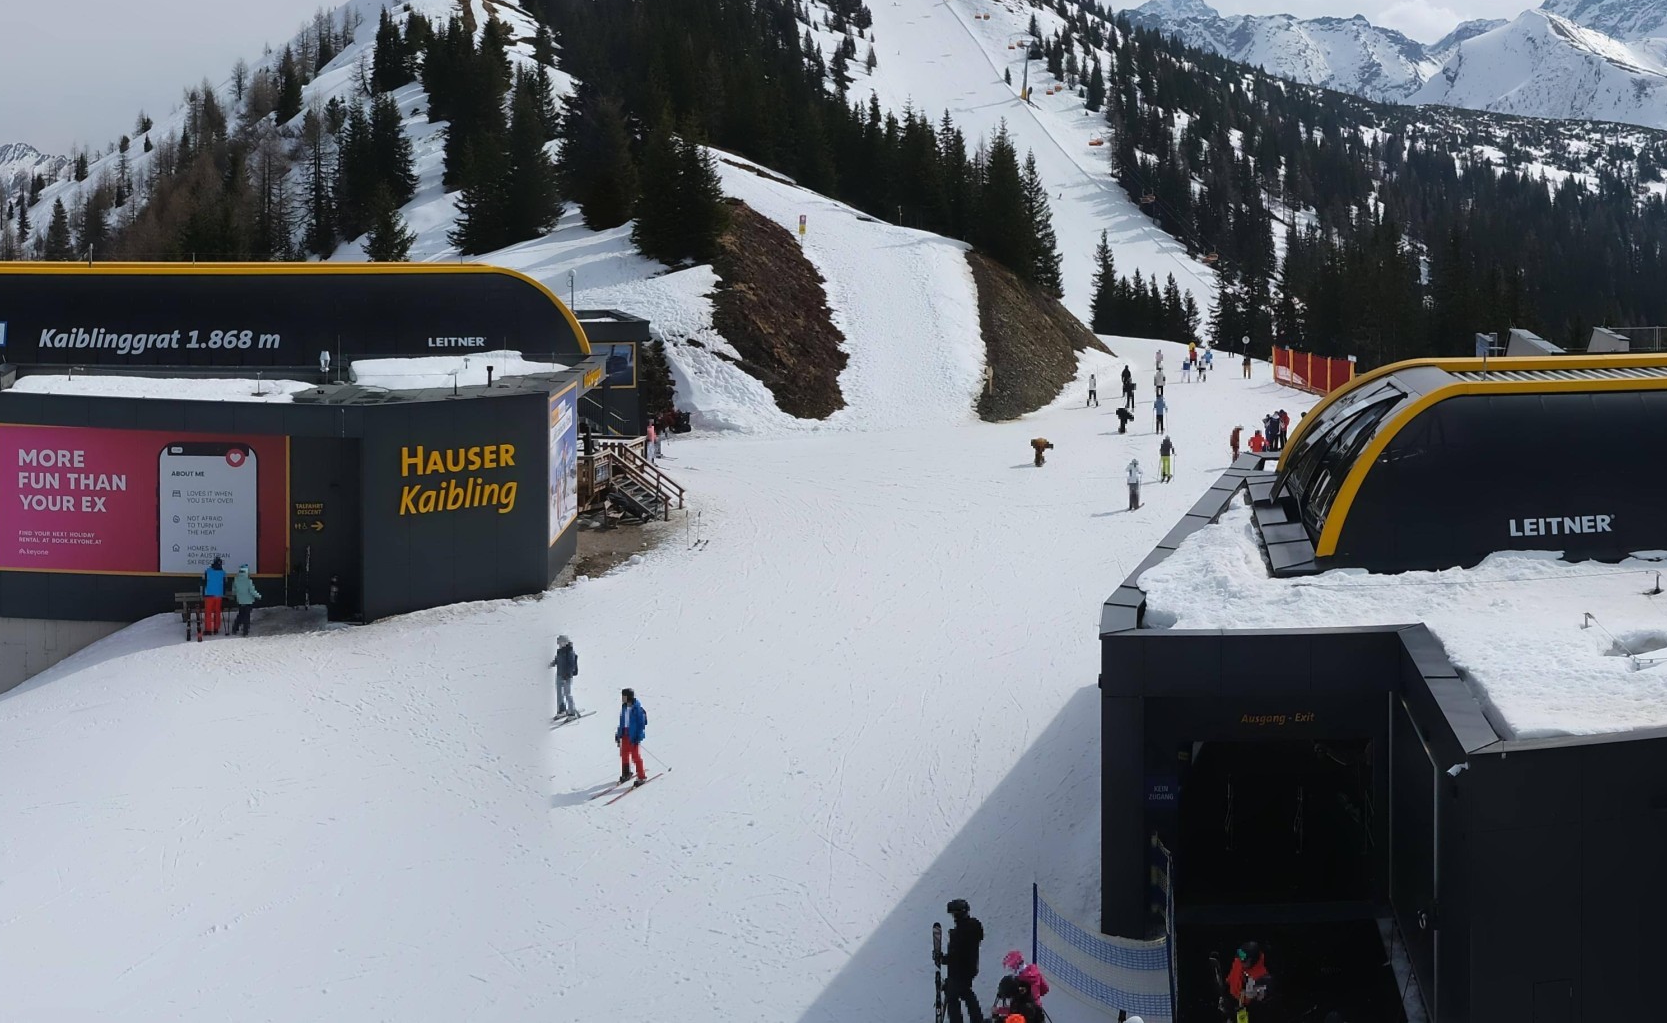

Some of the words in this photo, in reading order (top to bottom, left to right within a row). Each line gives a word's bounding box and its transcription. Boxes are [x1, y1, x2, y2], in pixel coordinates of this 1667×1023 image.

[38, 328, 181, 355] Kaiblinggrat
[186, 330, 253, 349] 1.868
[258, 333, 280, 349] m
[18, 449, 84, 468] MORE
[401, 444, 515, 477] HAUSER
[18, 472, 59, 489] FUN
[67, 473, 126, 491] THAN
[19, 495, 75, 511] YOUR
[81, 497, 107, 512] EX
[399, 477, 518, 515] Kaibling
[1509, 514, 1612, 537] LEITNER
[27, 548, 49, 556] keyone
[1241, 713, 1286, 725] Ausgang
[1295, 712, 1315, 722] Exit
[1149, 793, 1174, 801] ZUGANG
